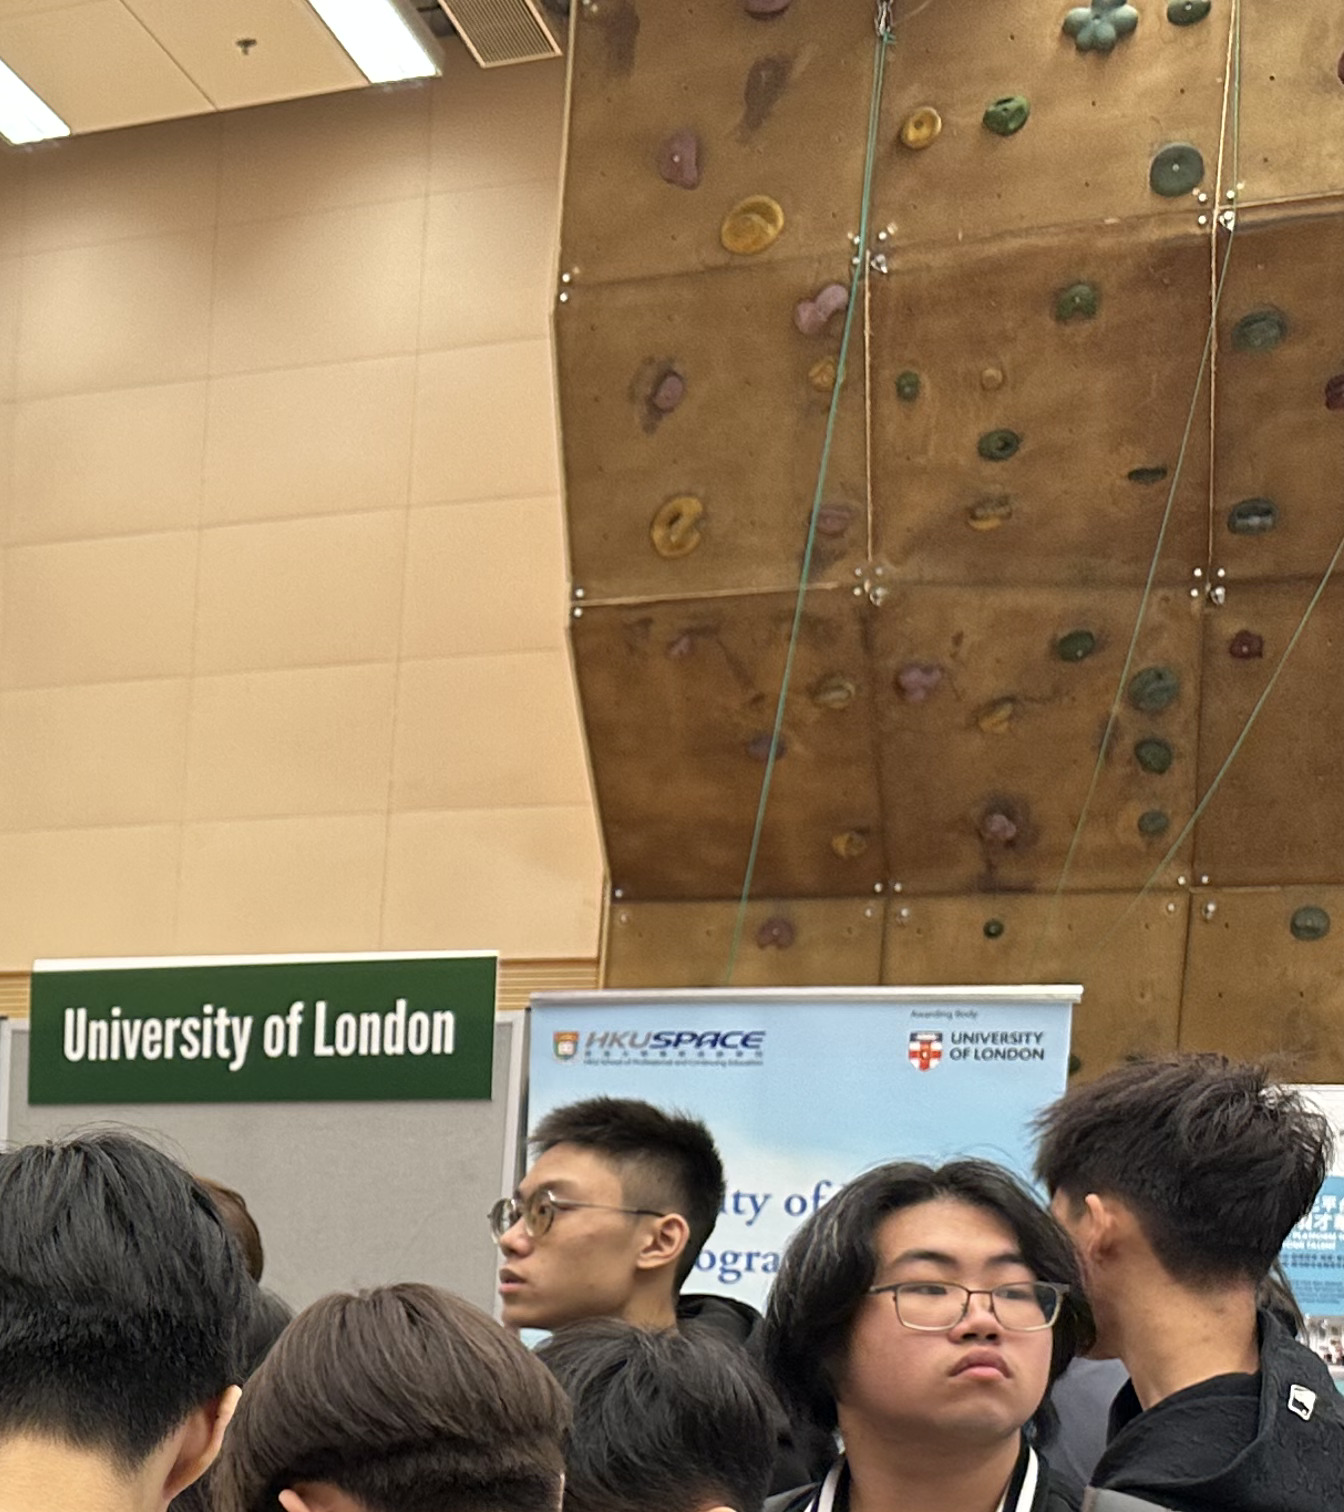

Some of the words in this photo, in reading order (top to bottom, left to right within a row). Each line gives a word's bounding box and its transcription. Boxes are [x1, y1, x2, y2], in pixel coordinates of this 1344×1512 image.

[63, 1004, 253, 1071] University
[263, 1001, 304, 1058] of
[314, 999, 455, 1057] London
[951, 1031, 1044, 1045] UNIVERSITY
[950, 1047, 970, 1061] OF
[974, 1047, 1045, 1061] LONDON
[784, 1180, 832, 1216] of
